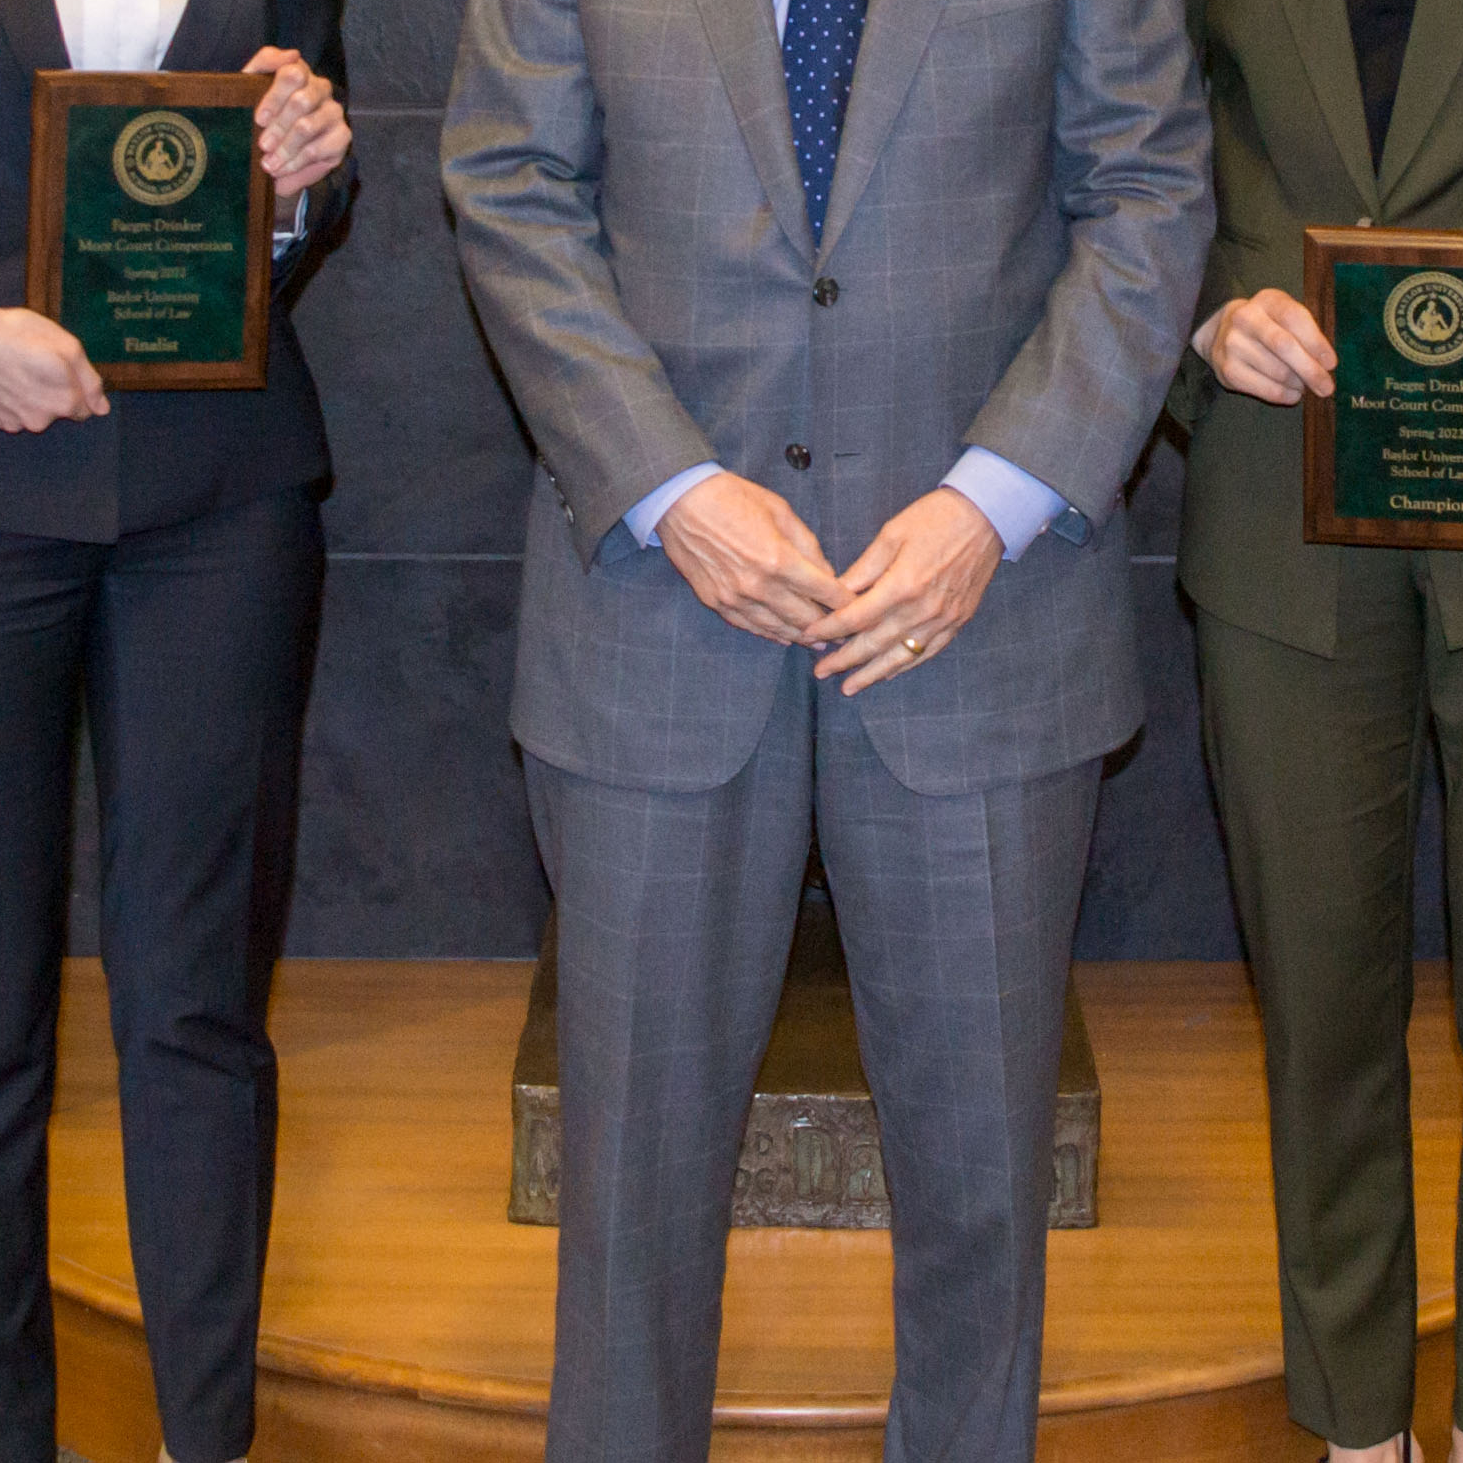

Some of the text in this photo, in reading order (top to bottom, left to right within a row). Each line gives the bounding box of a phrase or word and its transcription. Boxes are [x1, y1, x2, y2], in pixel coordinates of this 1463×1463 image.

[1351, 395, 1386, 410] Moot
[1389, 397, 1429, 412] Court
[1399, 426, 1436, 440] Spring
[1382, 448, 1420, 462] Baylor
[1390, 465, 1431, 479] School
[1432, 467, 1445, 479] of
